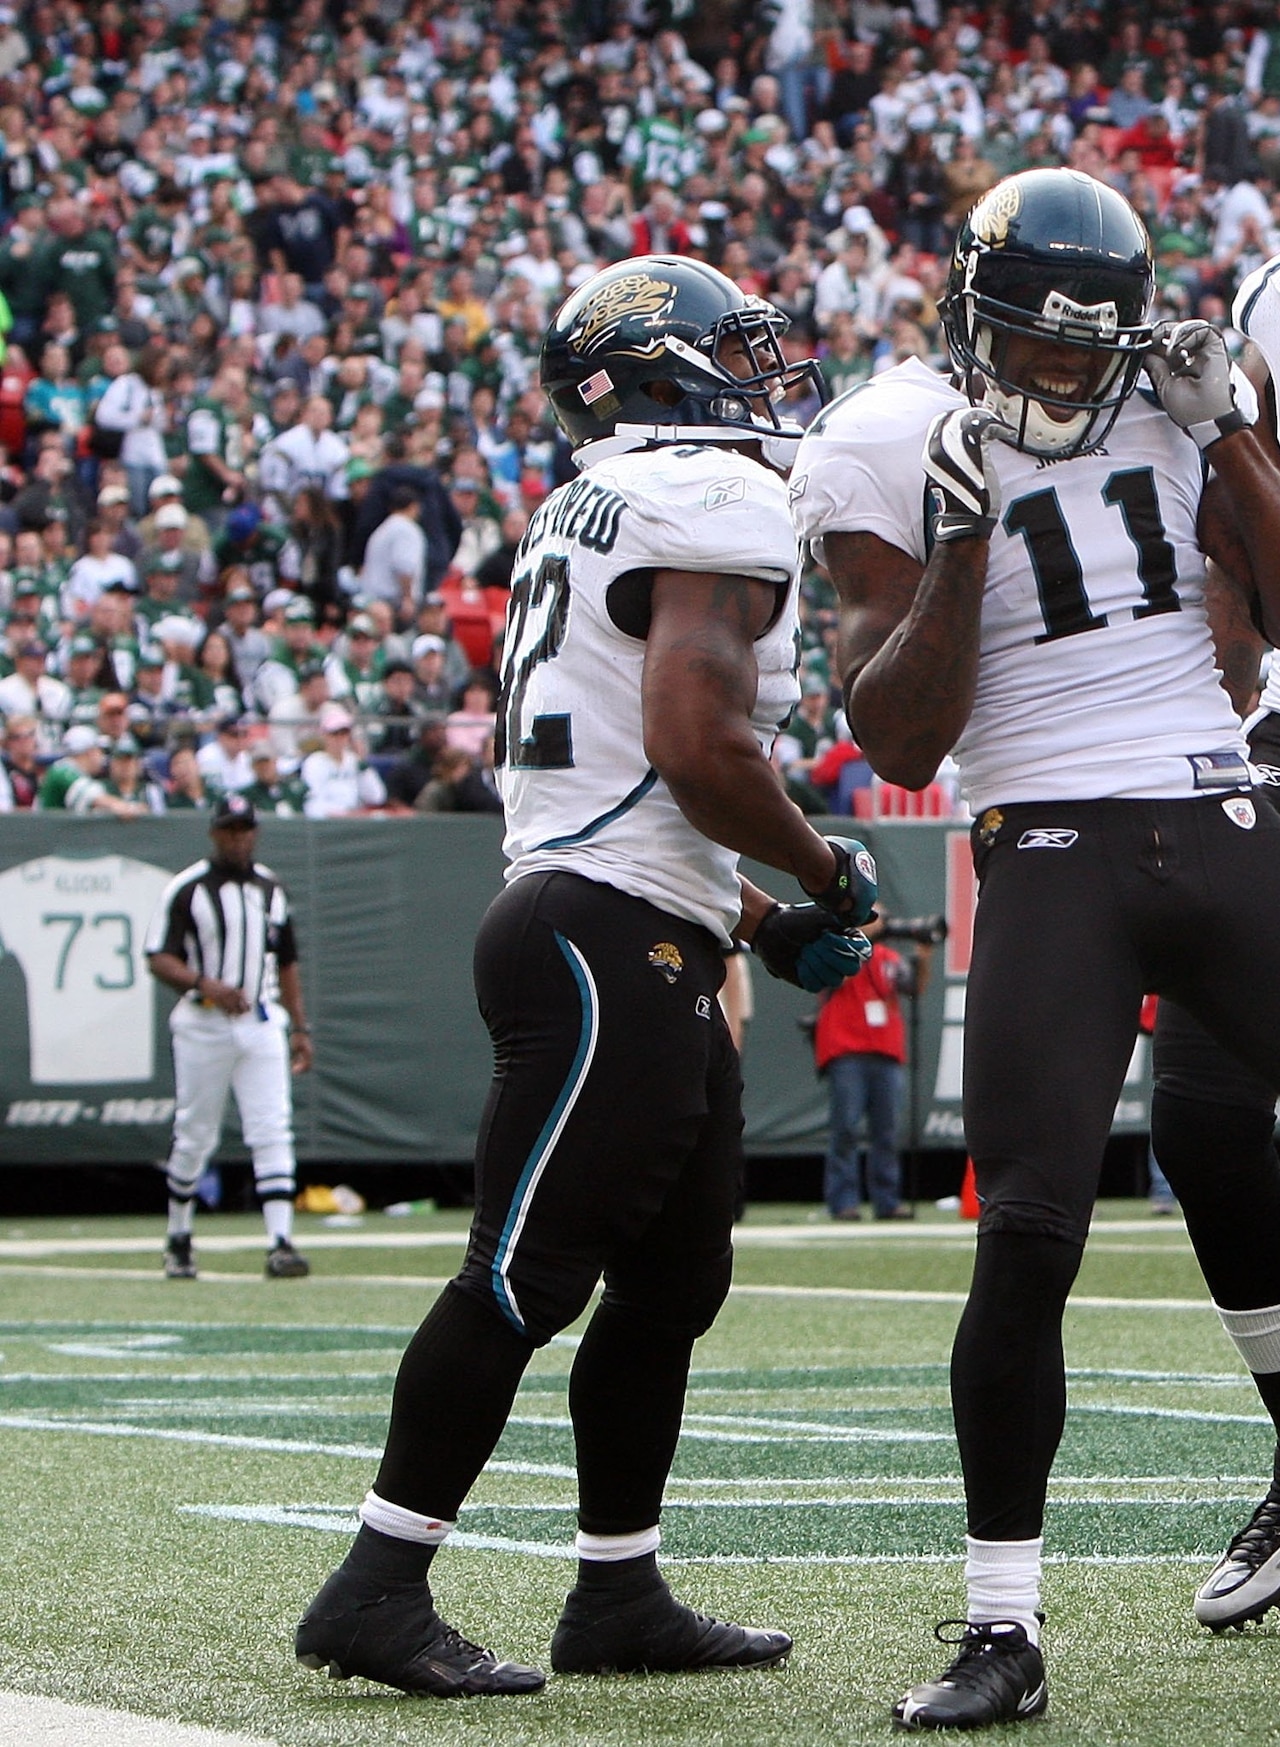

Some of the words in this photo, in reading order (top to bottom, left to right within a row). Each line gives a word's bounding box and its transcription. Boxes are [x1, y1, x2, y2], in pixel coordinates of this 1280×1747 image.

[1061, 304, 1100, 320] Riddell
[1001, 465, 1183, 646] 11
[42, 912, 135, 991] 73
